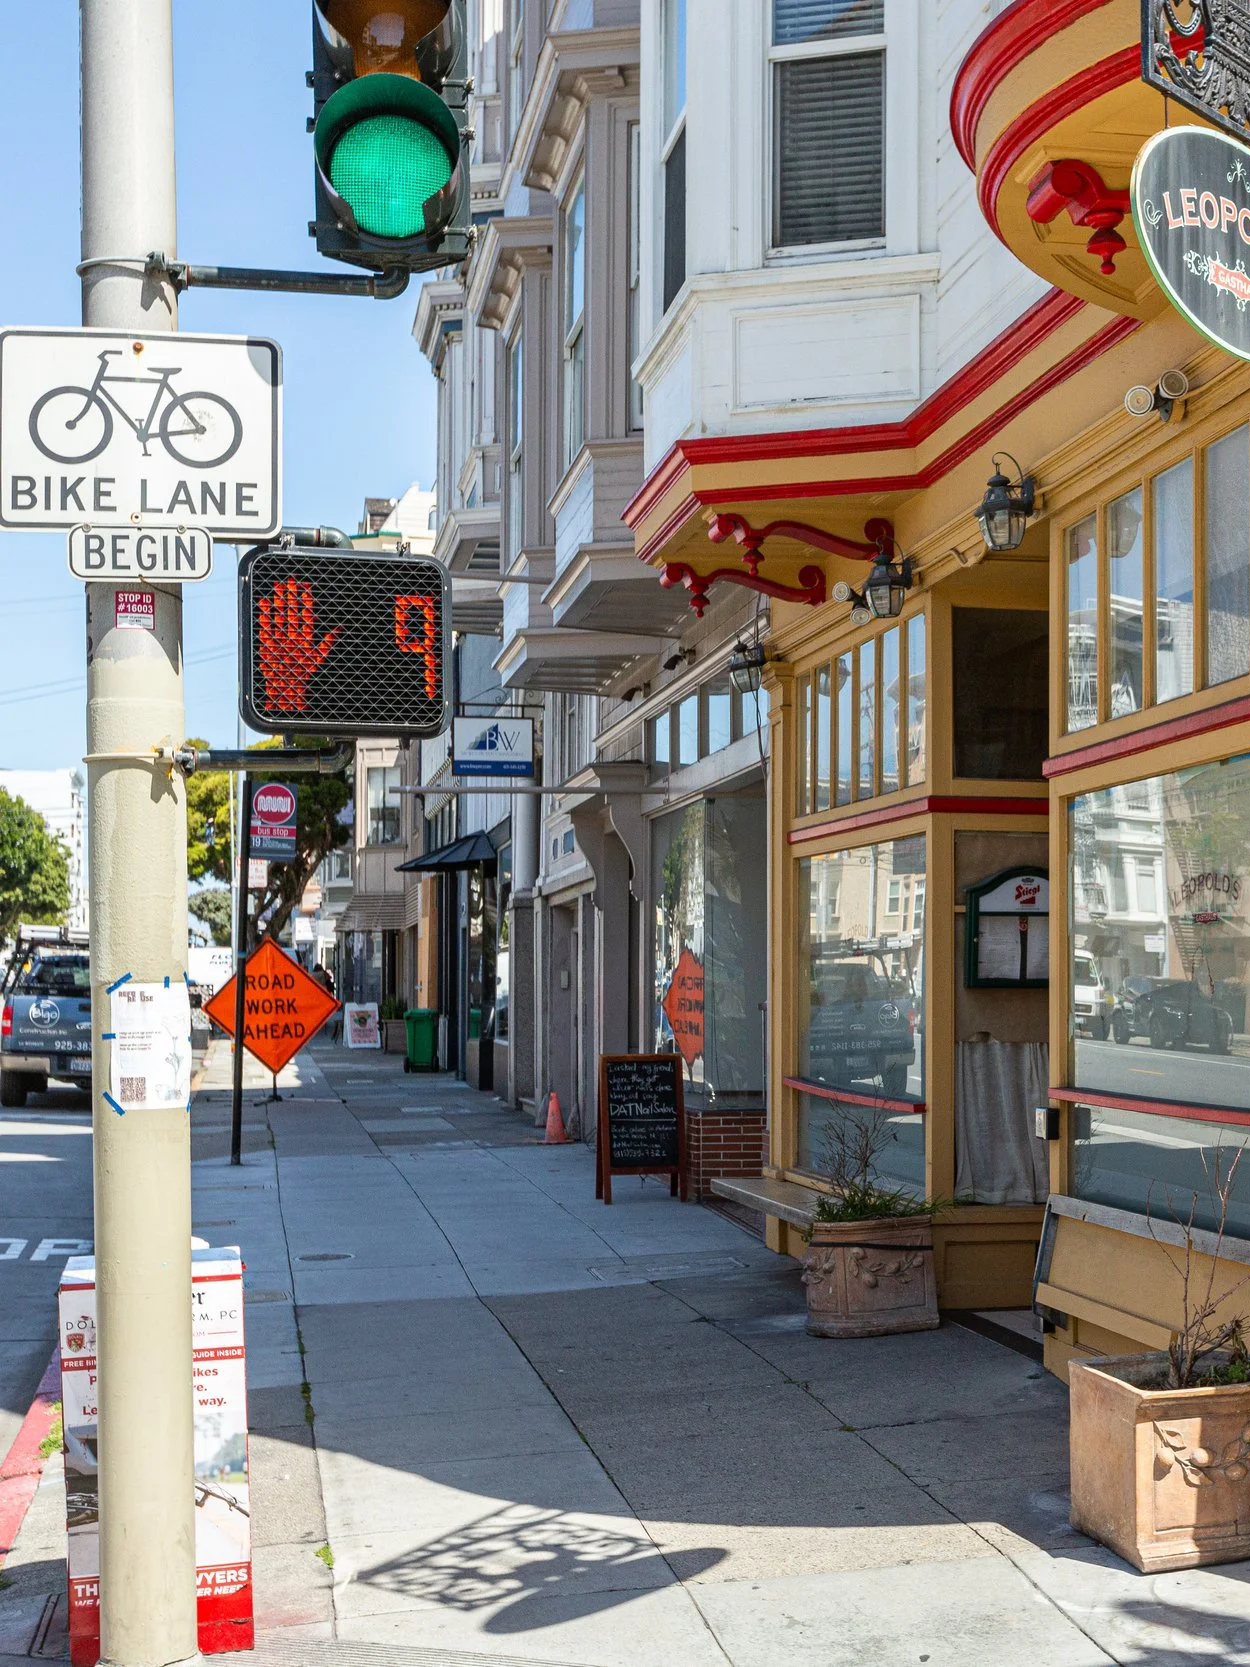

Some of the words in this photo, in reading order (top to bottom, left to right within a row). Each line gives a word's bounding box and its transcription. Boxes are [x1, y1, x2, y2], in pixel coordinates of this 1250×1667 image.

[11, 475, 117, 512] BIKE
[140, 478, 259, 517] LANE
[84, 534, 196, 571] BEGIN
[118, 593, 141, 603] STOP
[142, 594, 152, 603] ID
[117, 603, 153, 613] #16003
[394, 594, 438, 700] 9
[257, 826, 271, 835] bus
[272, 827, 289, 837] stop
[252, 838, 261, 847] 19
[1015, 884, 1040, 901] Stiegl
[1173, 873, 1242, 907] LEOPOLD'S
[246, 974, 295, 990] ROAD
[246, 998, 298, 1015] WORK
[243, 1023, 305, 1040] AHEAD
[219, 1309, 238, 1320] PC
[216, 1348, 243, 1357] INSIDE
[64, 1360, 84, 1368] FREE
[198, 1396, 227, 1407] way.
